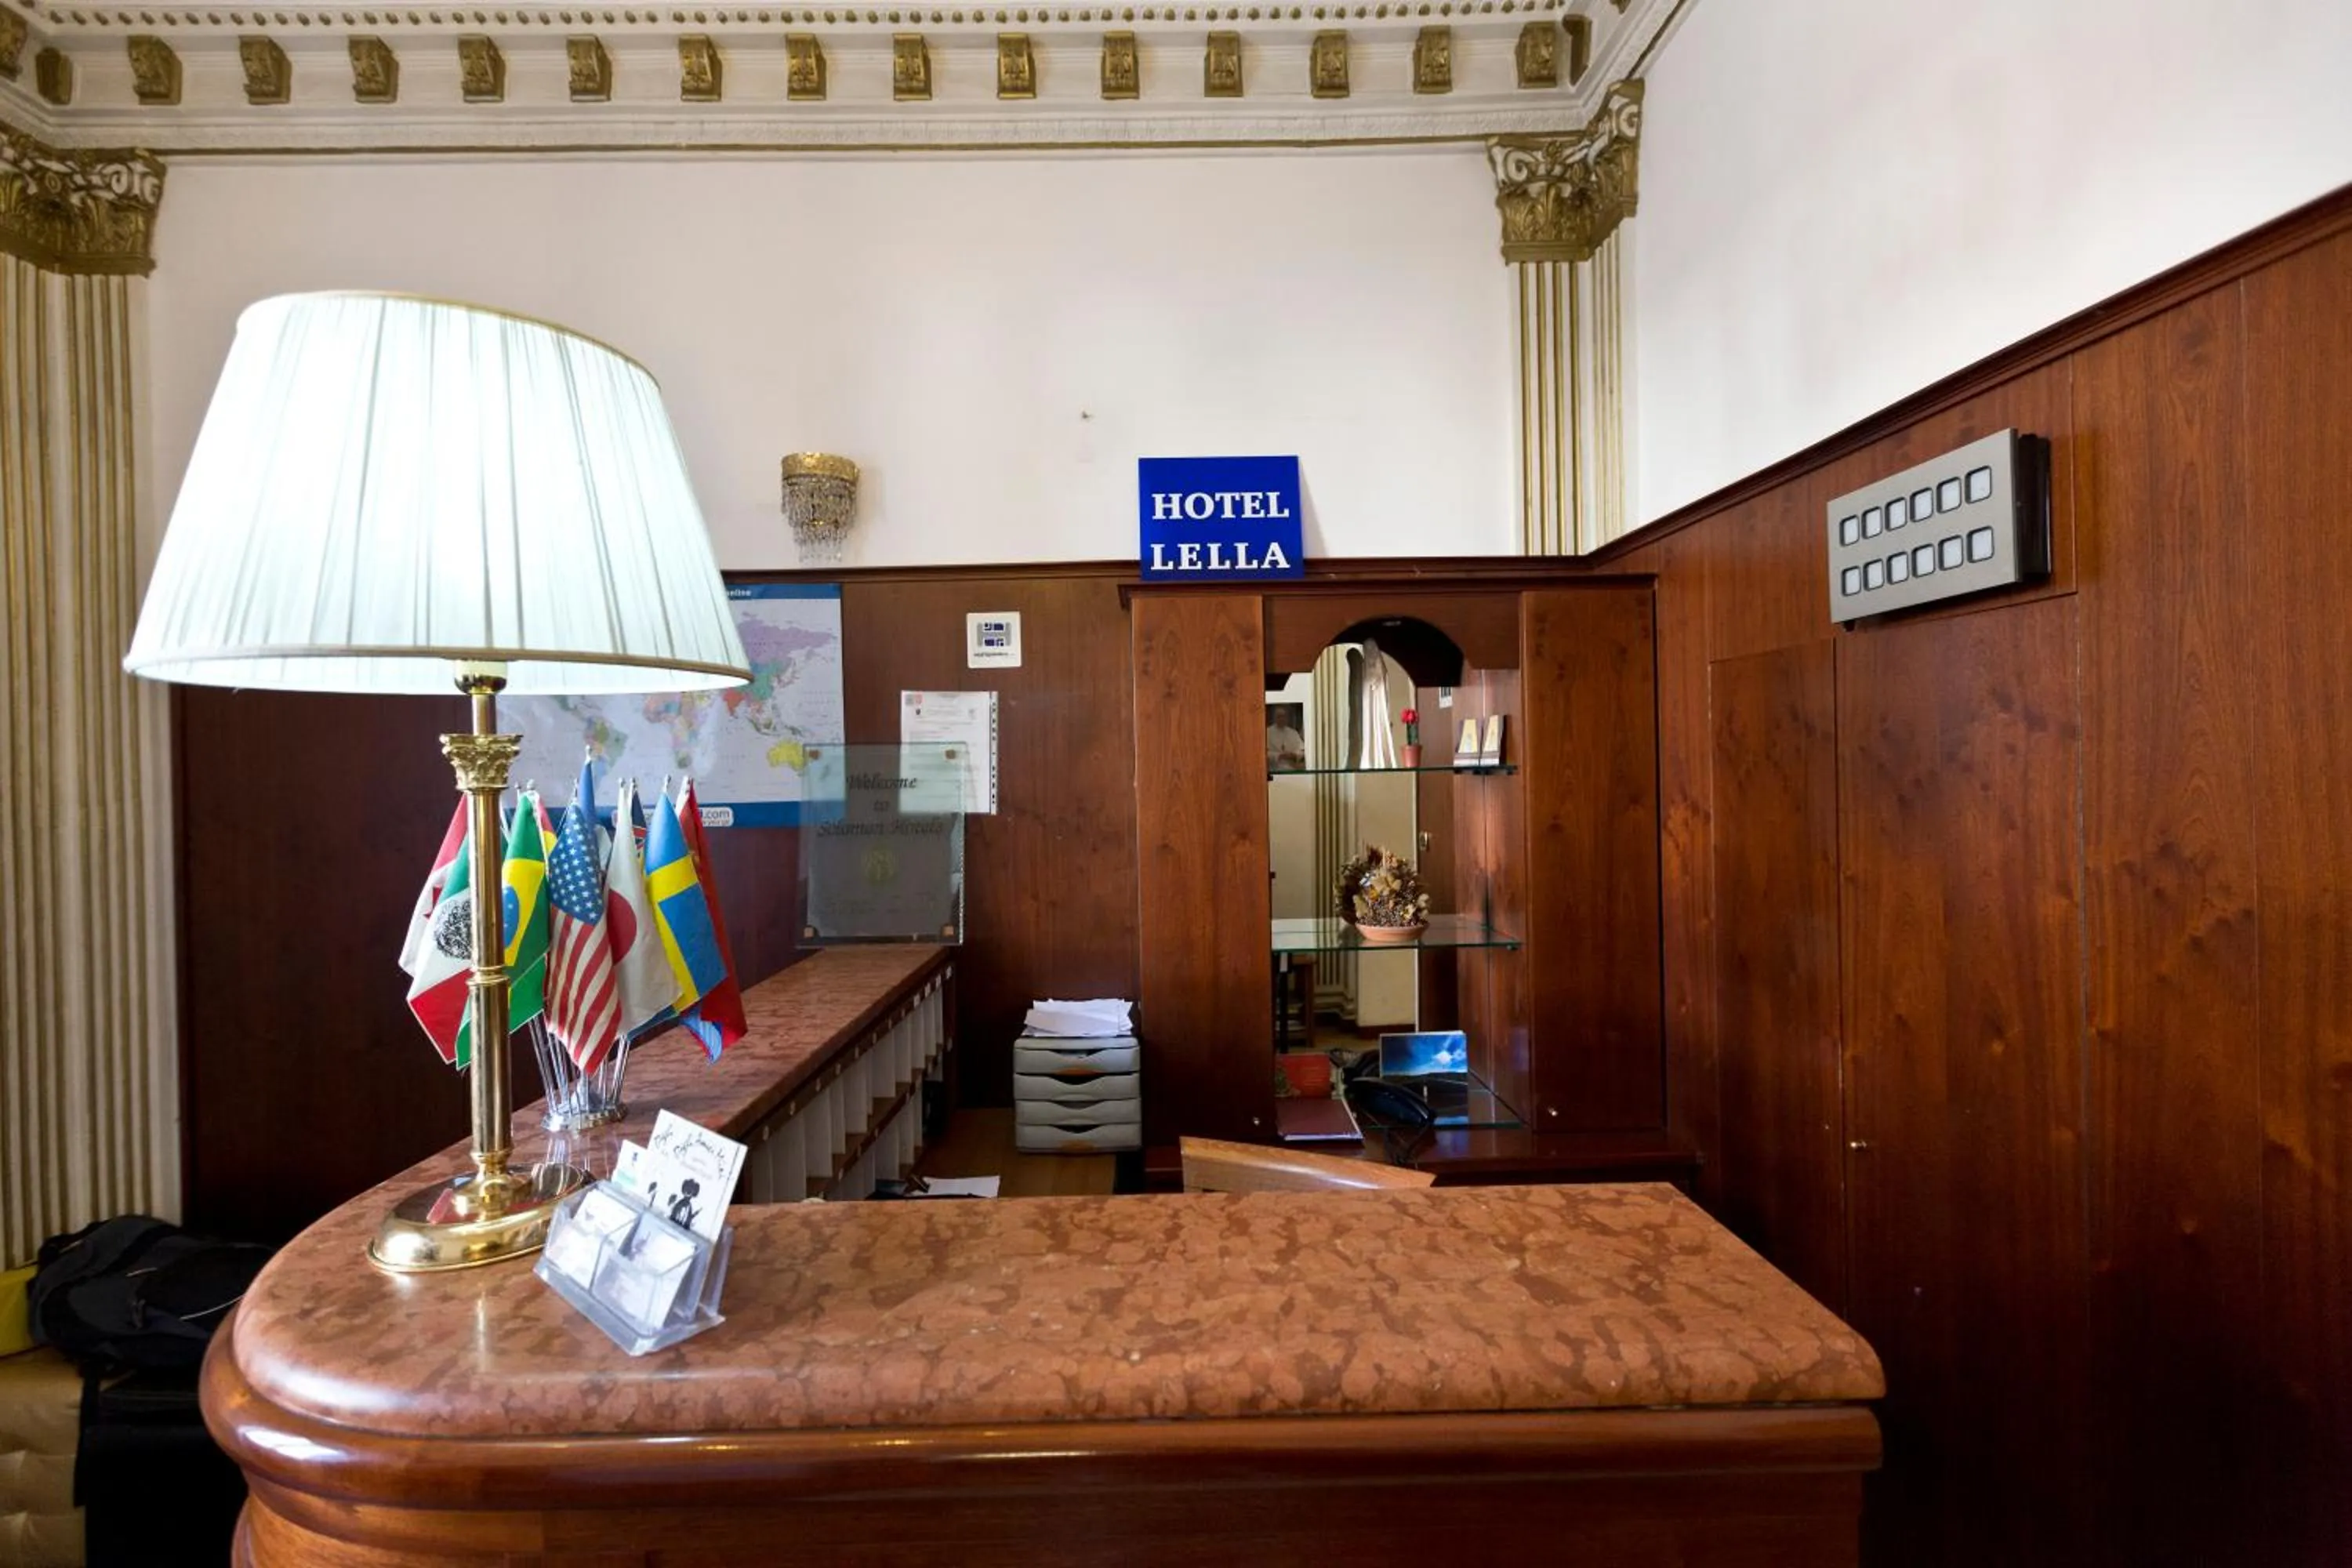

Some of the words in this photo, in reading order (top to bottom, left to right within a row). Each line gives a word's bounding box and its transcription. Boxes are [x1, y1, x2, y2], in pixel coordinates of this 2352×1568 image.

[1151, 492, 1290, 520] HOTEL
[1150, 542, 1290, 570] LELLA
[847, 772, 917, 789] Welcome
[873, 800, 890, 812] to
